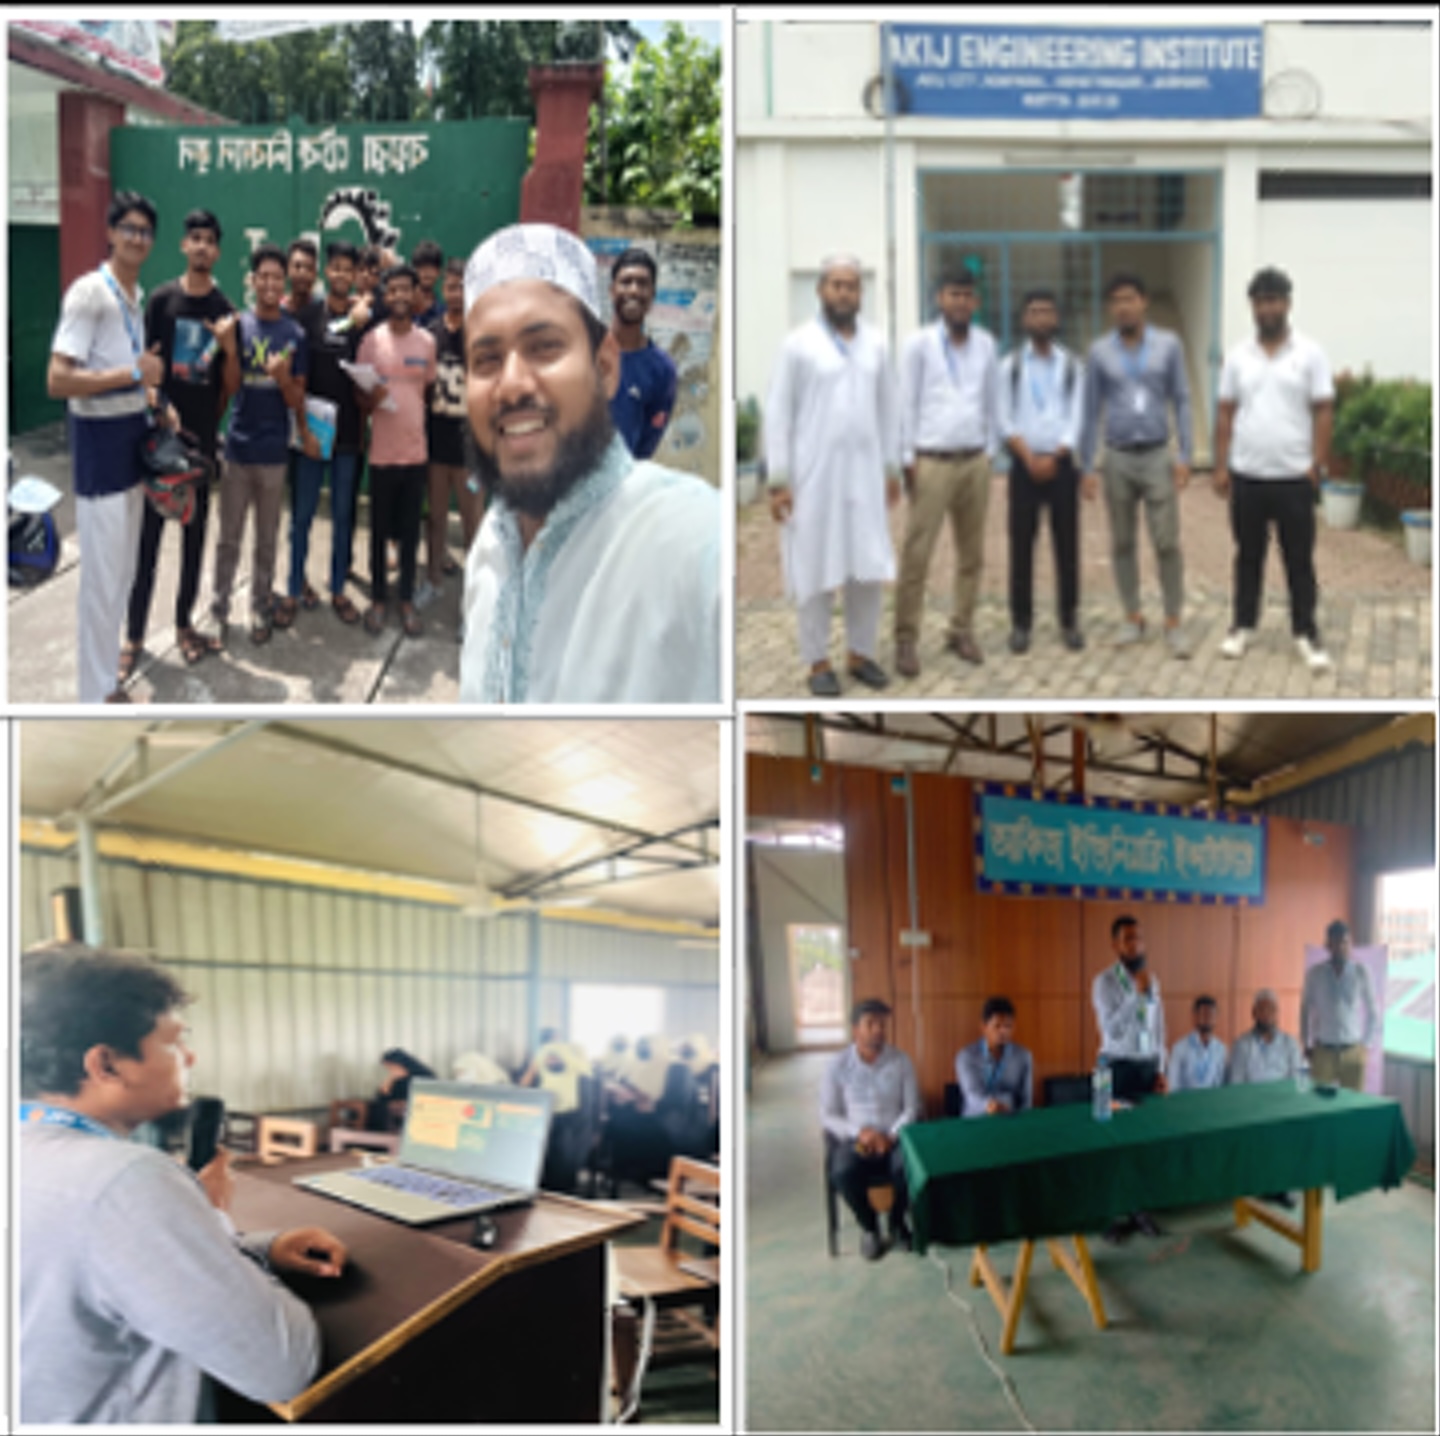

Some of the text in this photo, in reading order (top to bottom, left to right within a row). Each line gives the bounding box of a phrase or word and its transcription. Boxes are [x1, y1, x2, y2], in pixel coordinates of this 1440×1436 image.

[888, 33, 1260, 71] AKIJ ENGINEERING INSTITUTE
